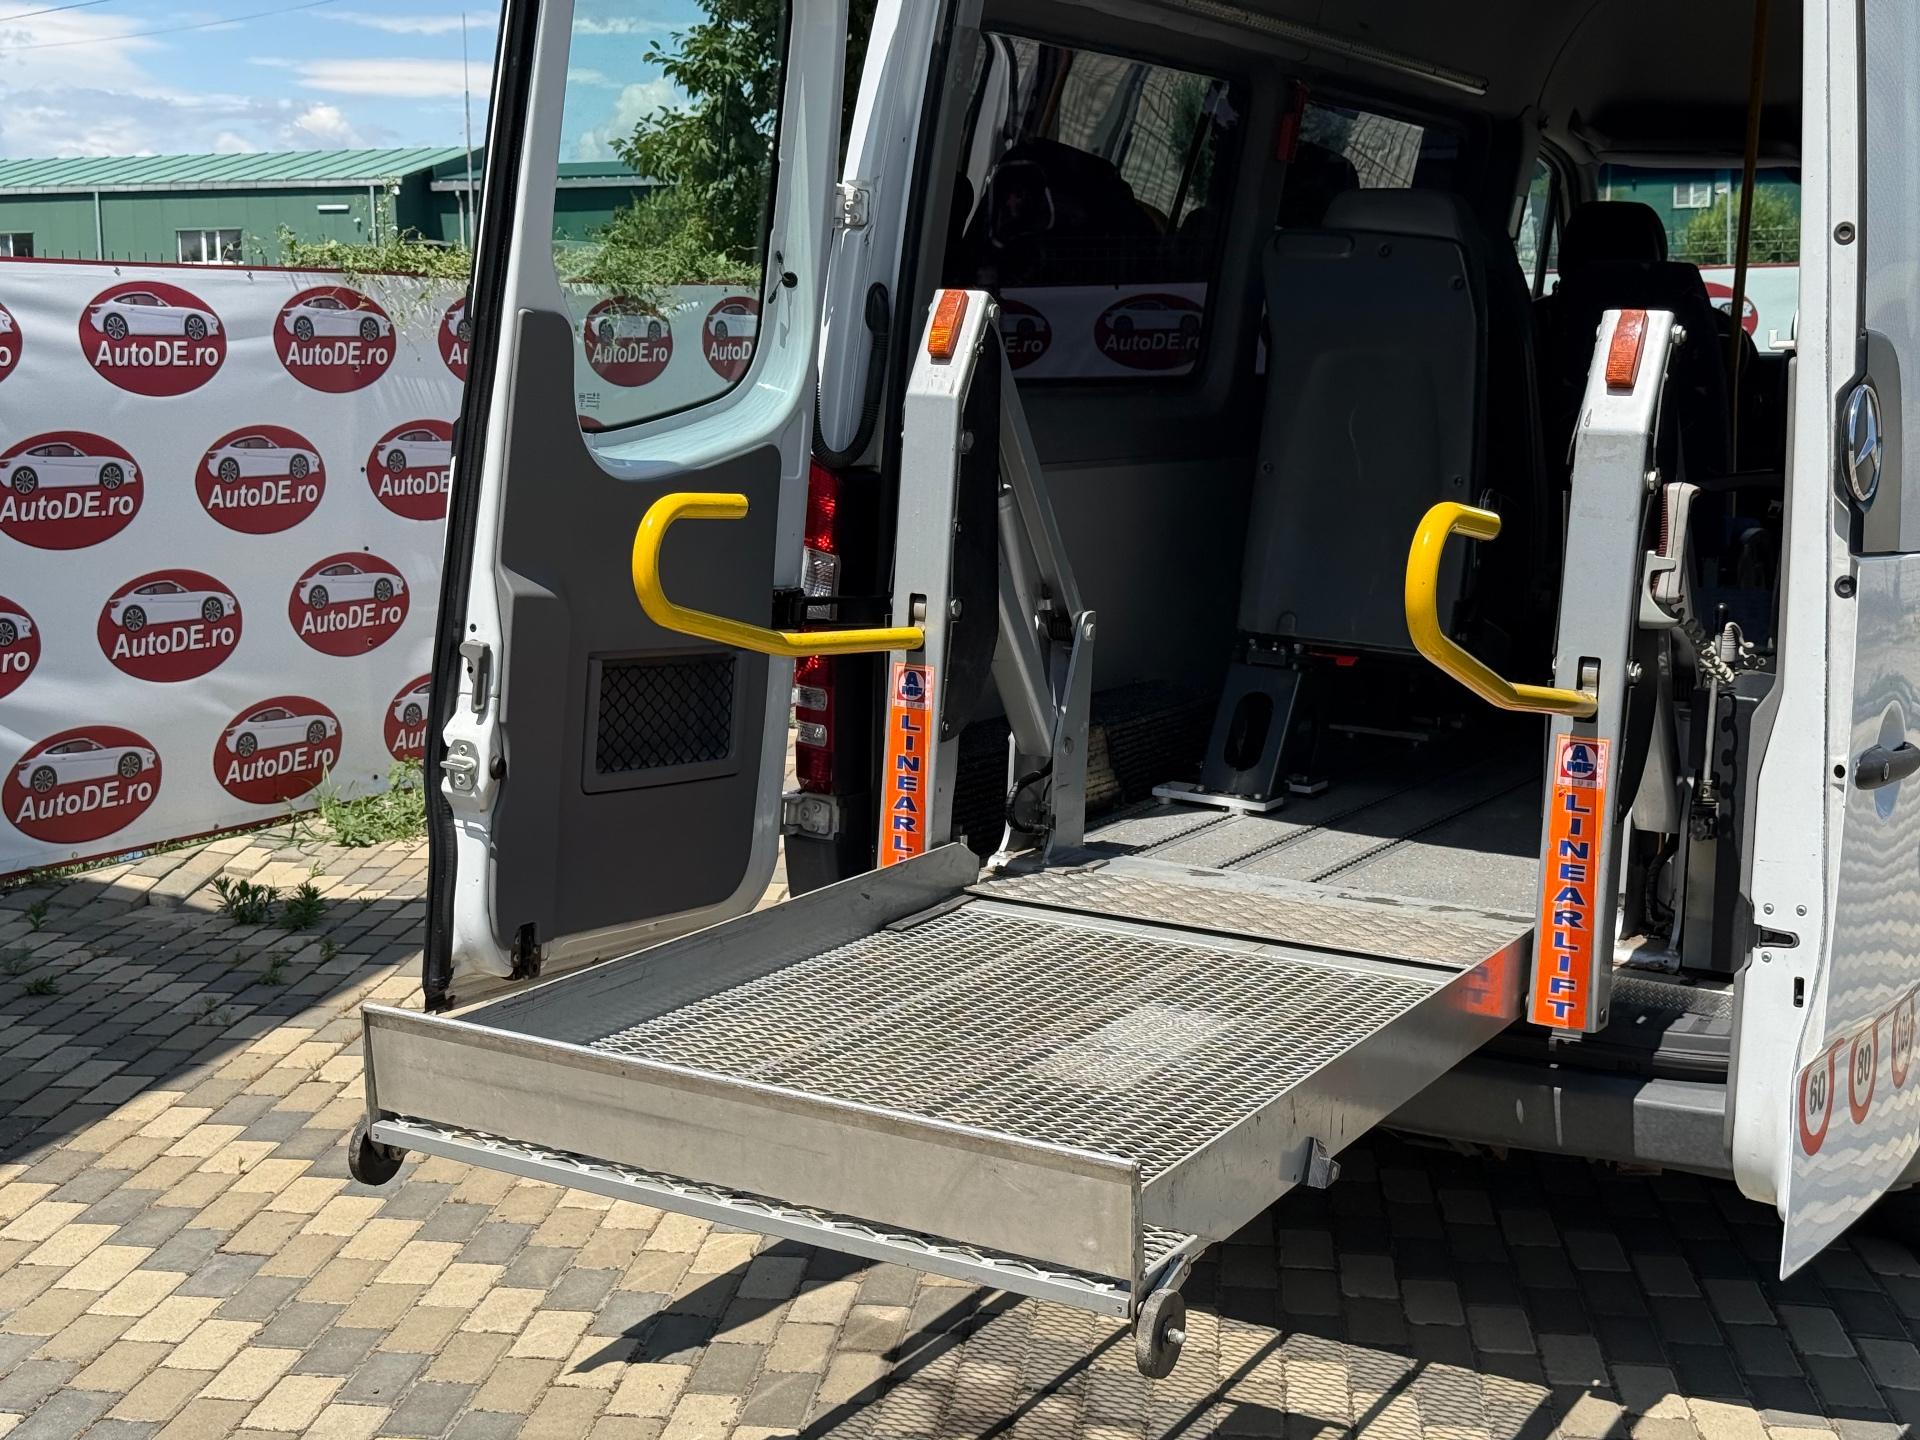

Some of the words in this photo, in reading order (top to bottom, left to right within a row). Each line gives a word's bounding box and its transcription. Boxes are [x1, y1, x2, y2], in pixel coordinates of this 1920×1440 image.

[95, 340, 219, 367] AutoDE.ro
[286, 341, 388, 366] AutoDE.ro
[591, 340, 668, 364] AutoDE.ro
[0, 491, 134, 523] AutoDE.ro
[207, 481, 318, 509] AutoDE.ro
[301, 603, 402, 635] AutoDE.ro
[112, 624, 235, 660] AutoDE.ro
[225, 747, 335, 785] AutoDE.ro
[16, 781, 152, 823] AutoDE.ro
[1546, 794, 1591, 1018] LINEARLIFT
[1856, 1043, 1871, 1085] 80
[1809, 1069, 1826, 1115] 60
